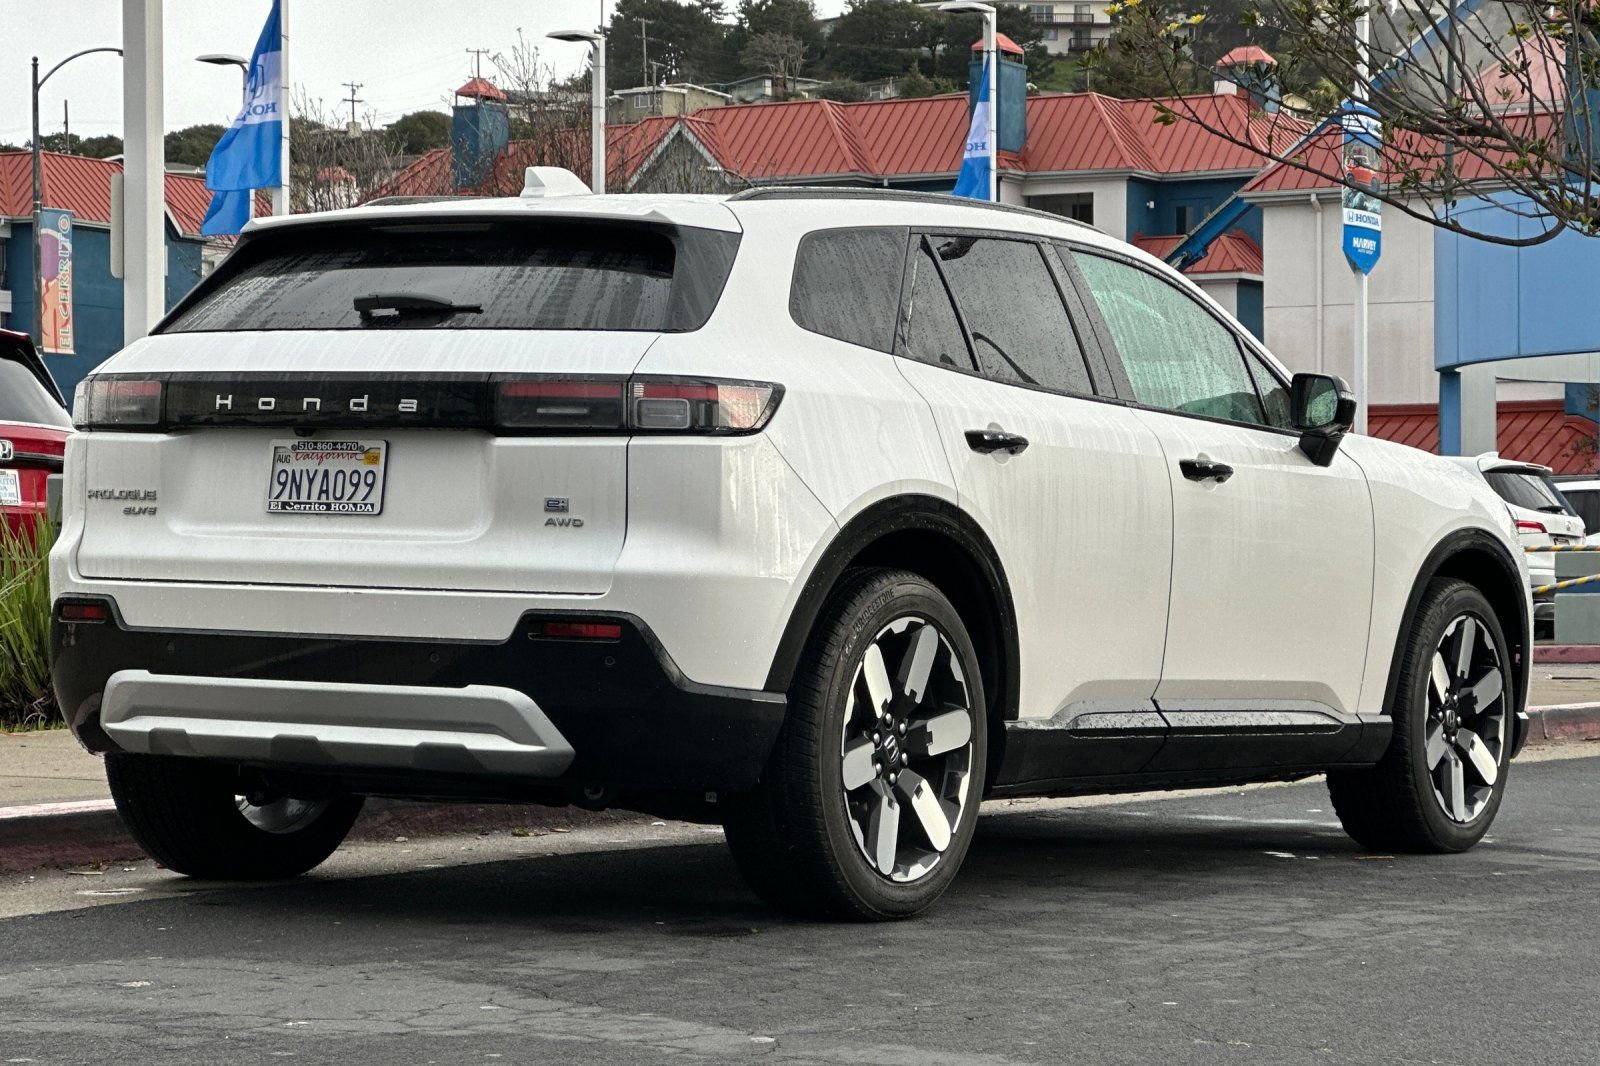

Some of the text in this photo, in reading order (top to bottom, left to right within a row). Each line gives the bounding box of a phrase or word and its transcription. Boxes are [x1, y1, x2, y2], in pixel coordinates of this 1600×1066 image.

[1352, 236, 1377, 251] HARVEY
[58, 213, 72, 348] EL CERRITO
[215, 394, 418, 412] Honda
[298, 442, 357, 450] 510-860-4470
[277, 454, 291, 463] AUG
[274, 468, 376, 501] 9NYA099
[269, 502, 373, 512] El Cerrito HONDA
[544, 517, 584, 527] AWD
